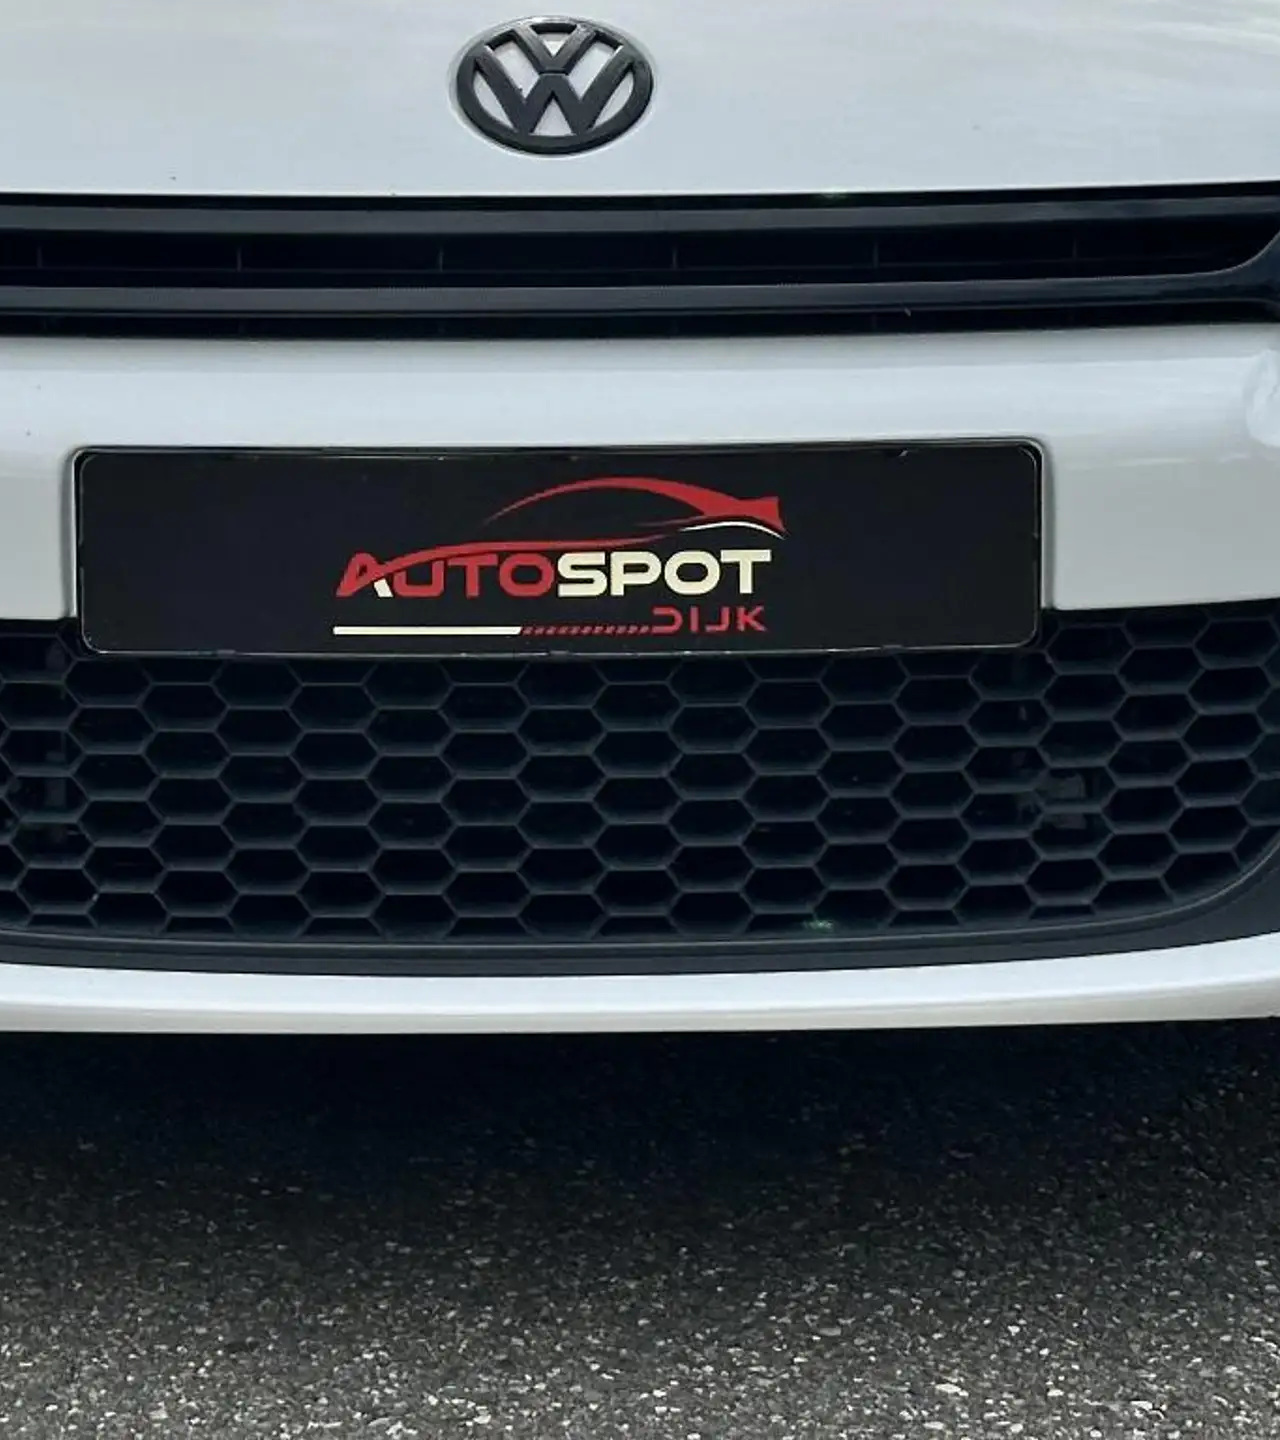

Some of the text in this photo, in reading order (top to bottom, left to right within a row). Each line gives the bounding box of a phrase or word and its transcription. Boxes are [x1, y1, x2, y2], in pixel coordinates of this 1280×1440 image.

[464, 18, 646, 144] VW
[336, 549, 772, 598] AUTOSPOT
[652, 605, 768, 633] DIJK
